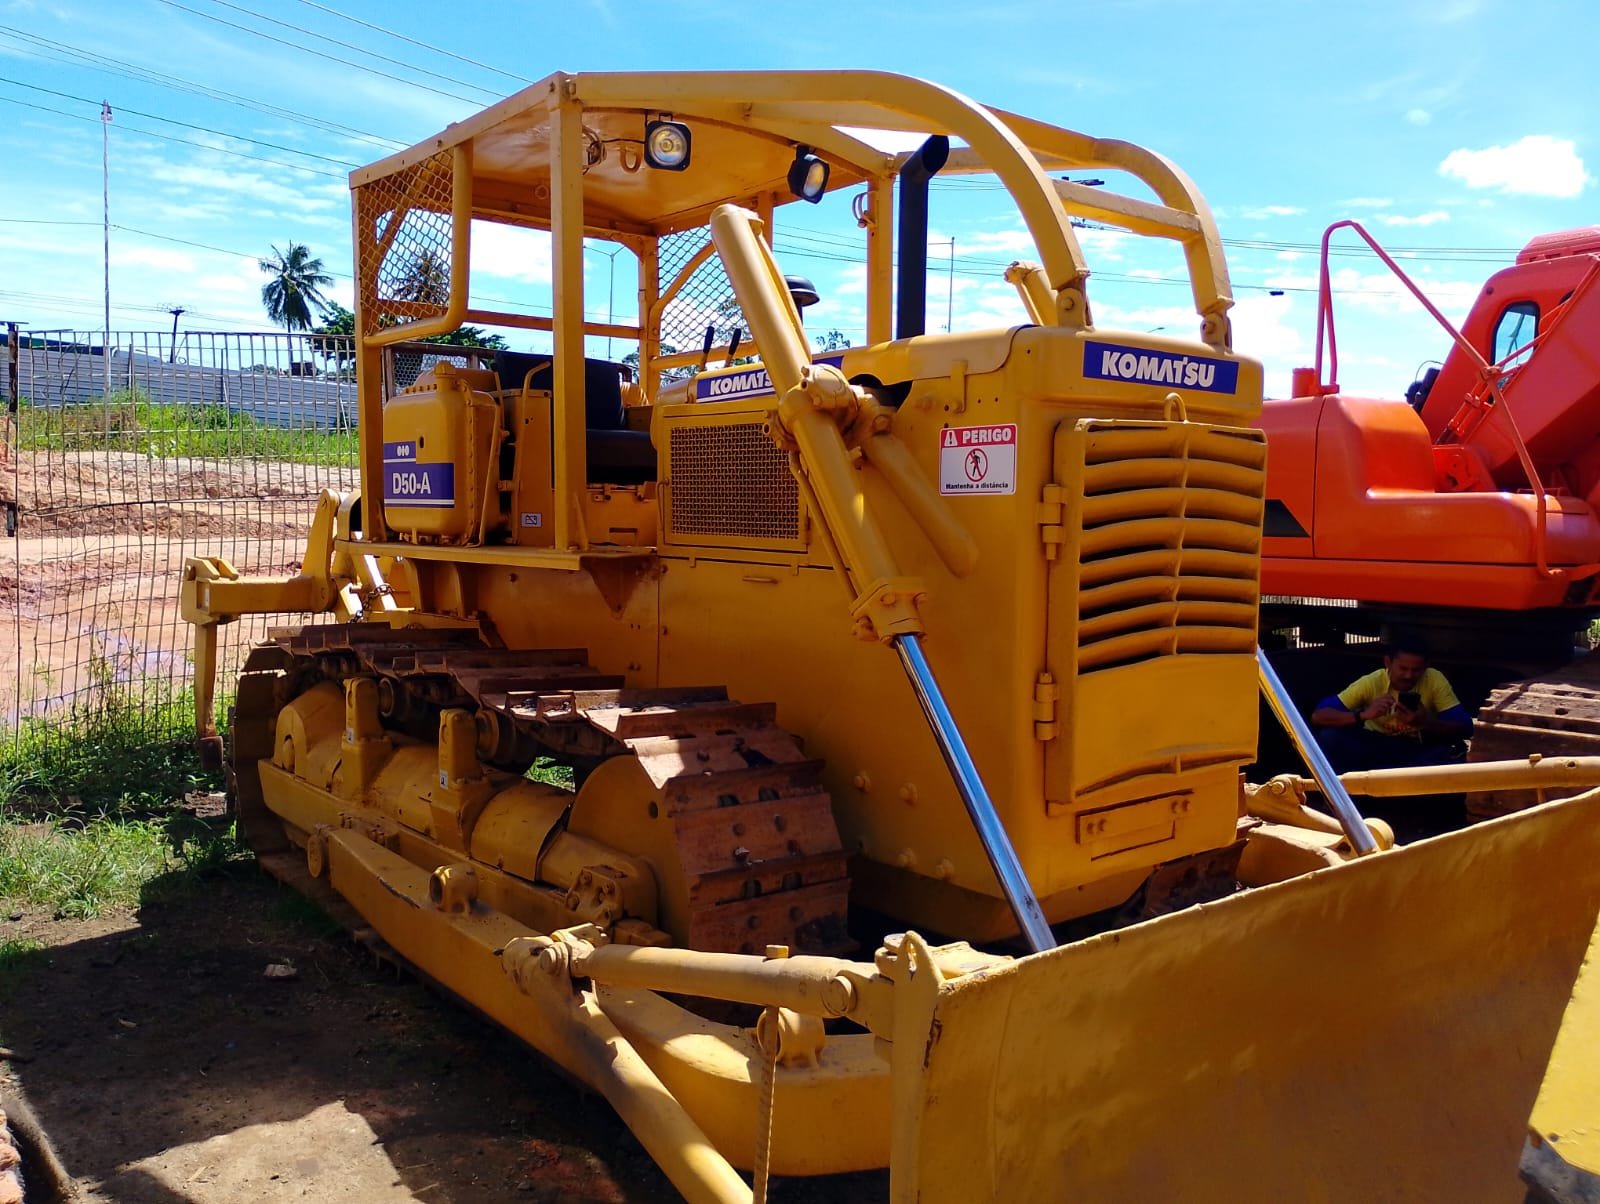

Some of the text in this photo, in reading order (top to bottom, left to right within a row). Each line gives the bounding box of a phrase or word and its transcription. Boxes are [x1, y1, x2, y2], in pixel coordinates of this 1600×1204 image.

[1101, 350, 1216, 388] KOMATSU
[710, 370, 774, 396] KOMATS
[962, 427, 1012, 444] PERIGO
[392, 472, 431, 495] D50-A
[945, 482, 974, 490] Mantenha
